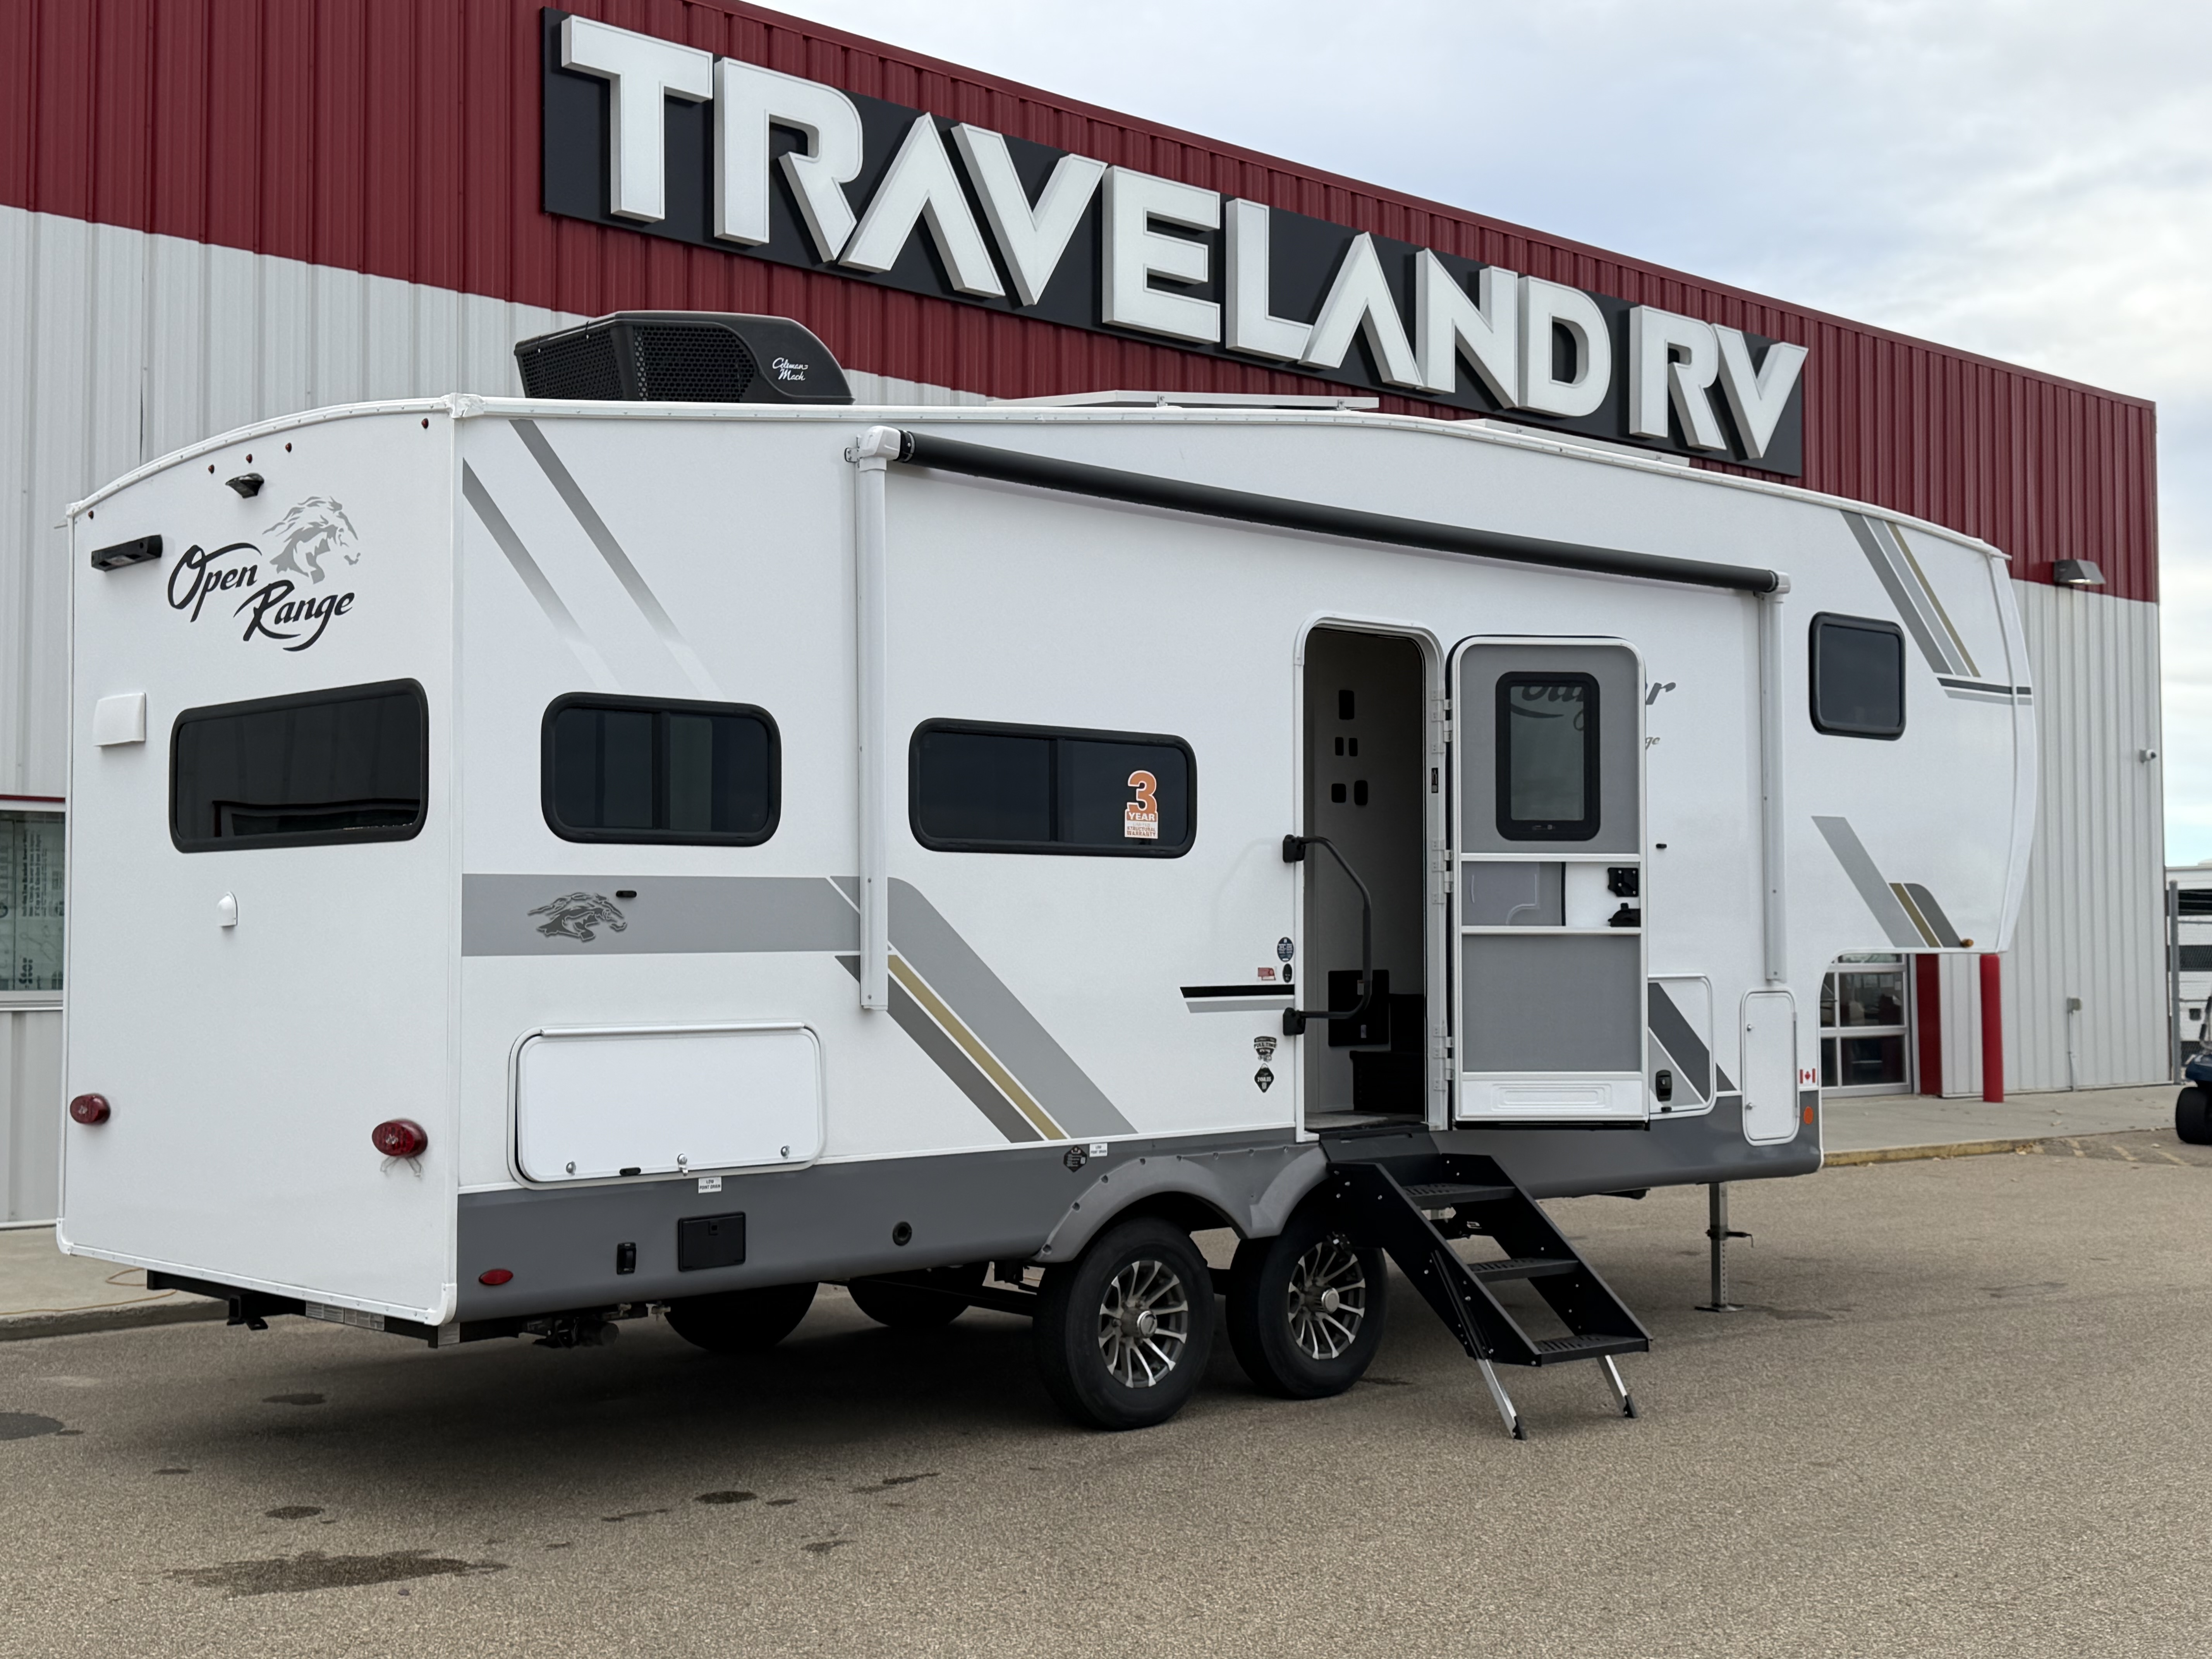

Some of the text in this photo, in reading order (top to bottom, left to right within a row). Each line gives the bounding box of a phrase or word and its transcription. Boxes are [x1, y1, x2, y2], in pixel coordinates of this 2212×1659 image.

[561, 14, 1808, 460] TRAVELAND RV
[772, 357, 809, 370] Coleman
[778, 368, 805, 381] Mach
[168, 543, 262, 622] Open
[234, 580, 355, 652] Range
[1128, 770, 1157, 812] 3
[1128, 812, 1155, 821] YEAR
